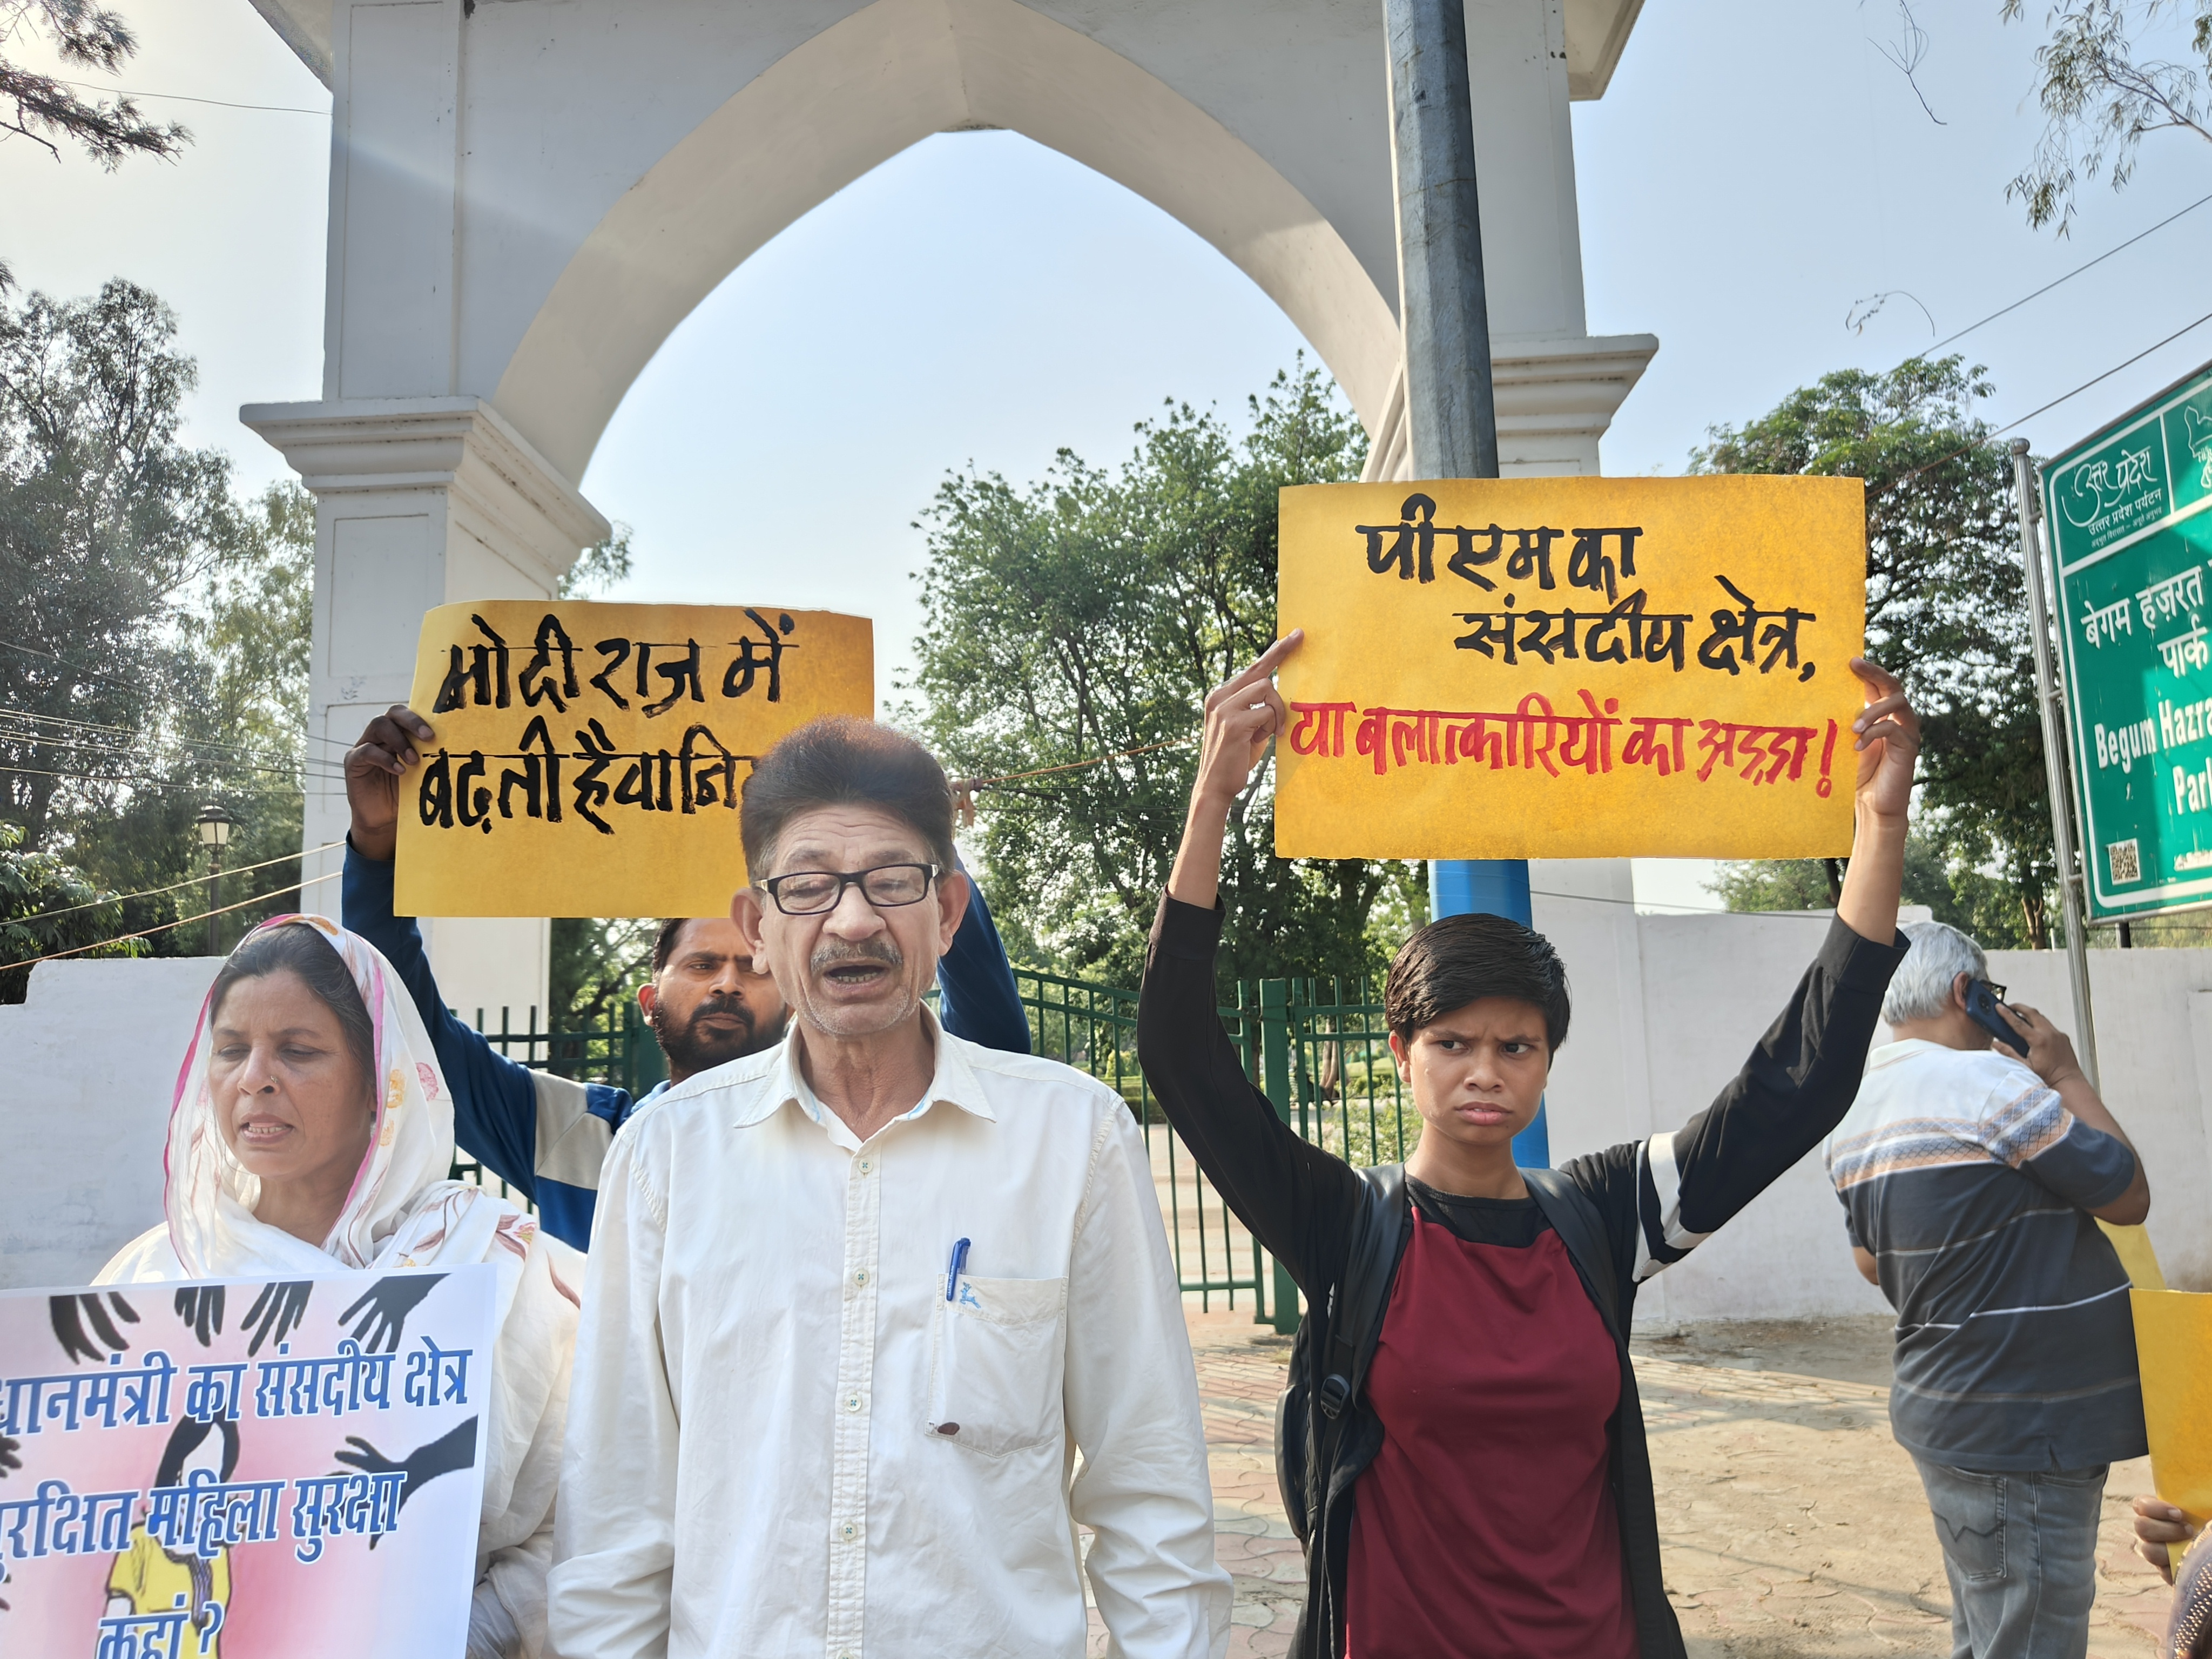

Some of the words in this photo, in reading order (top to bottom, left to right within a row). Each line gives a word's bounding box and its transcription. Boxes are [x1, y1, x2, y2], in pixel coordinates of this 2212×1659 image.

[1355, 493, 1564, 592] पीएम
[1568, 525, 1643, 603] का
[2111, 503, 2133, 524] प्रदेश
[2135, 488, 2161, 511] पर्यटन
[1452, 588, 1692, 672] संसदीय
[2080, 597, 2132, 650] बेगम
[2135, 565, 2204, 630] हज़रत
[2156, 613, 2209, 679] पार्क
[433, 613, 583, 714] मोदी
[722, 608, 800, 703] में
[573, 718, 757, 834] हैवानि
[1290, 702, 1357, 757] या
[1622, 717, 1694, 777] का
[2094, 718, 2157, 774] Begum
[186, 1363, 247, 1423] का
[256, 1338, 395, 1417] संसदीय
[404, 1336, 474, 1407] क्षेत्र
[146, 1469, 286, 1561] महिला
[292, 1472, 409, 1565] सुरक्षा
